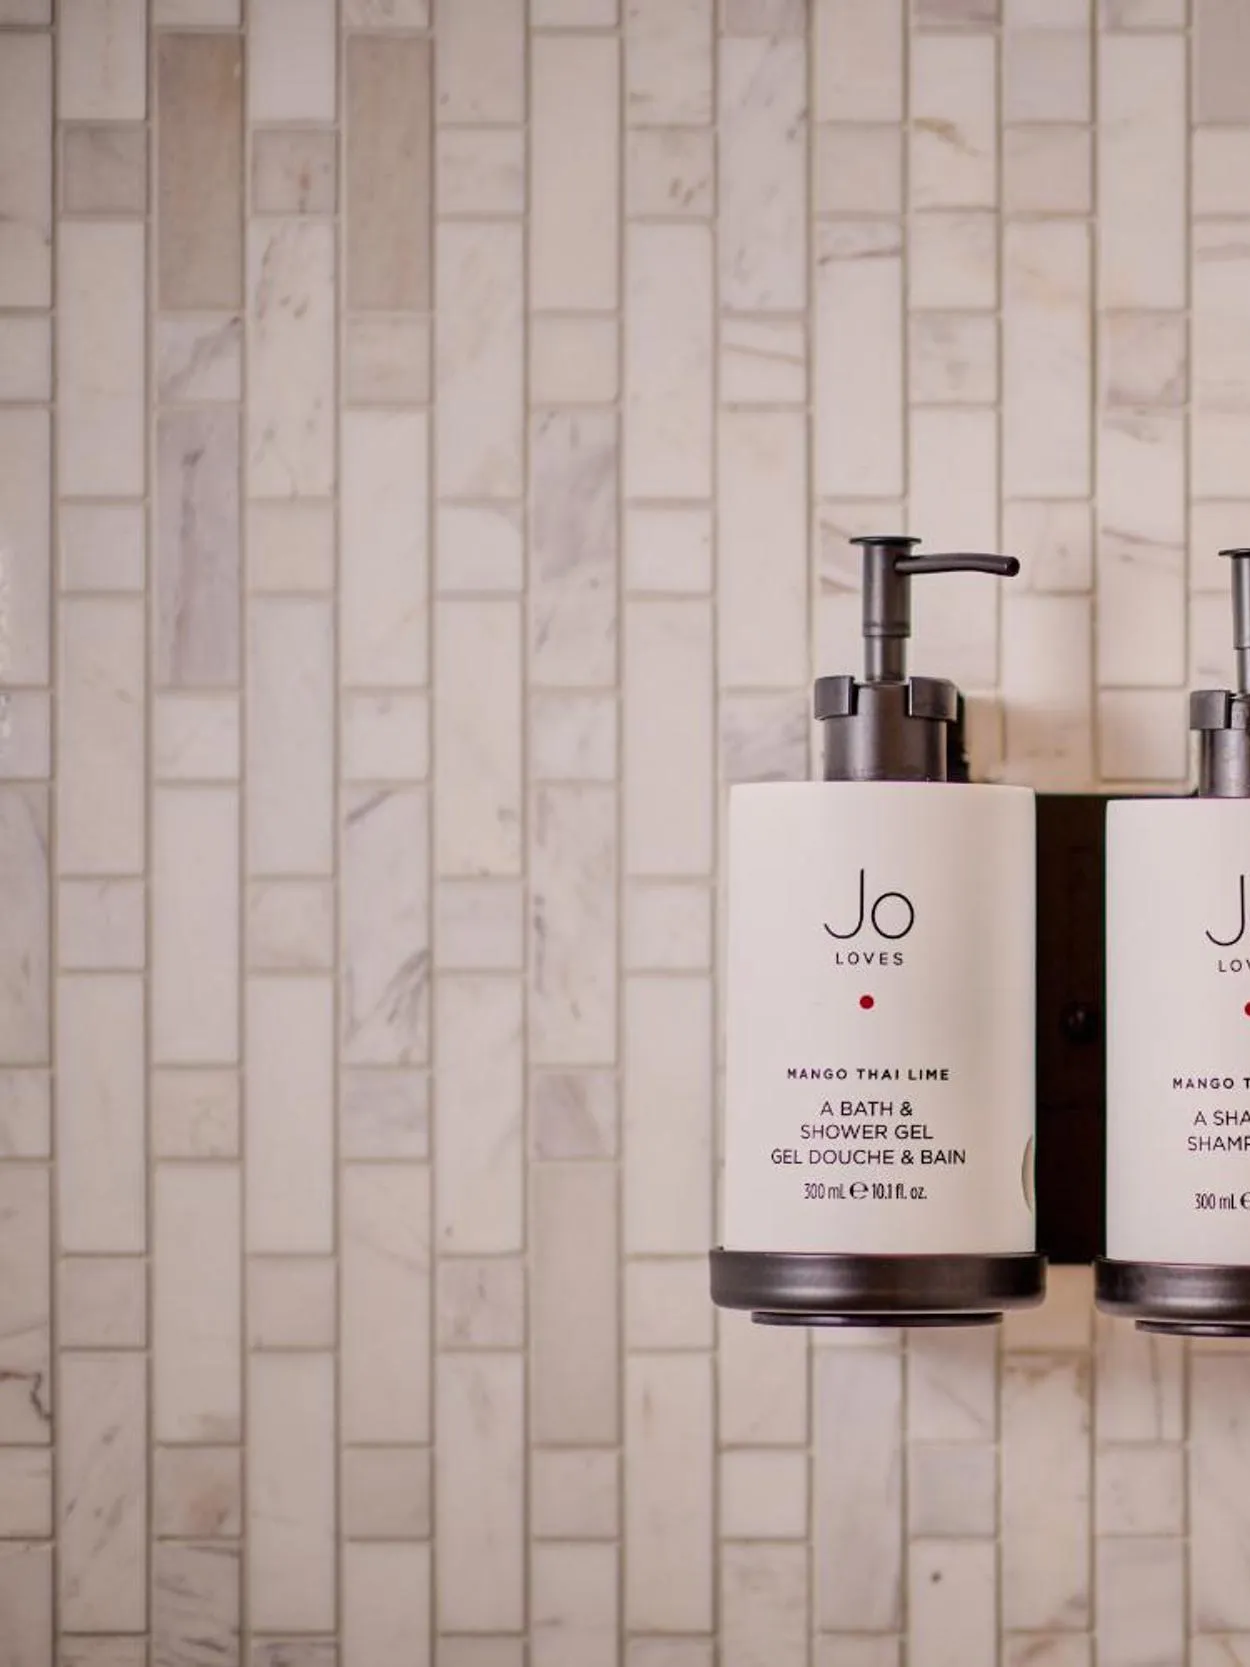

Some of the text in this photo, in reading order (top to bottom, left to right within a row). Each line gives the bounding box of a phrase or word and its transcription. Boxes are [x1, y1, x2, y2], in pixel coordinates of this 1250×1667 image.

[835, 950, 904, 967] LOVES
[787, 1067, 950, 1081] MANGO THAI LIME
[1172, 1075, 1235, 1090] MANGO
[819, 1100, 914, 1117] A BATH &
[1193, 1109, 1208, 1127] A
[799, 1123, 934, 1141] SHOWER GEL
[770, 1147, 967, 1166] GEL DOUCHE & BAIN
[803, 1182, 826, 1200] 300
[827, 1183, 847, 1200] mL
[871, 1182, 893, 1200] 10.1
[895, 1182, 908, 1200] fl.
[909, 1185, 928, 1200] oz.
[1194, 1192, 1217, 1210] 300
[1219, 1192, 1238, 1210] mL
